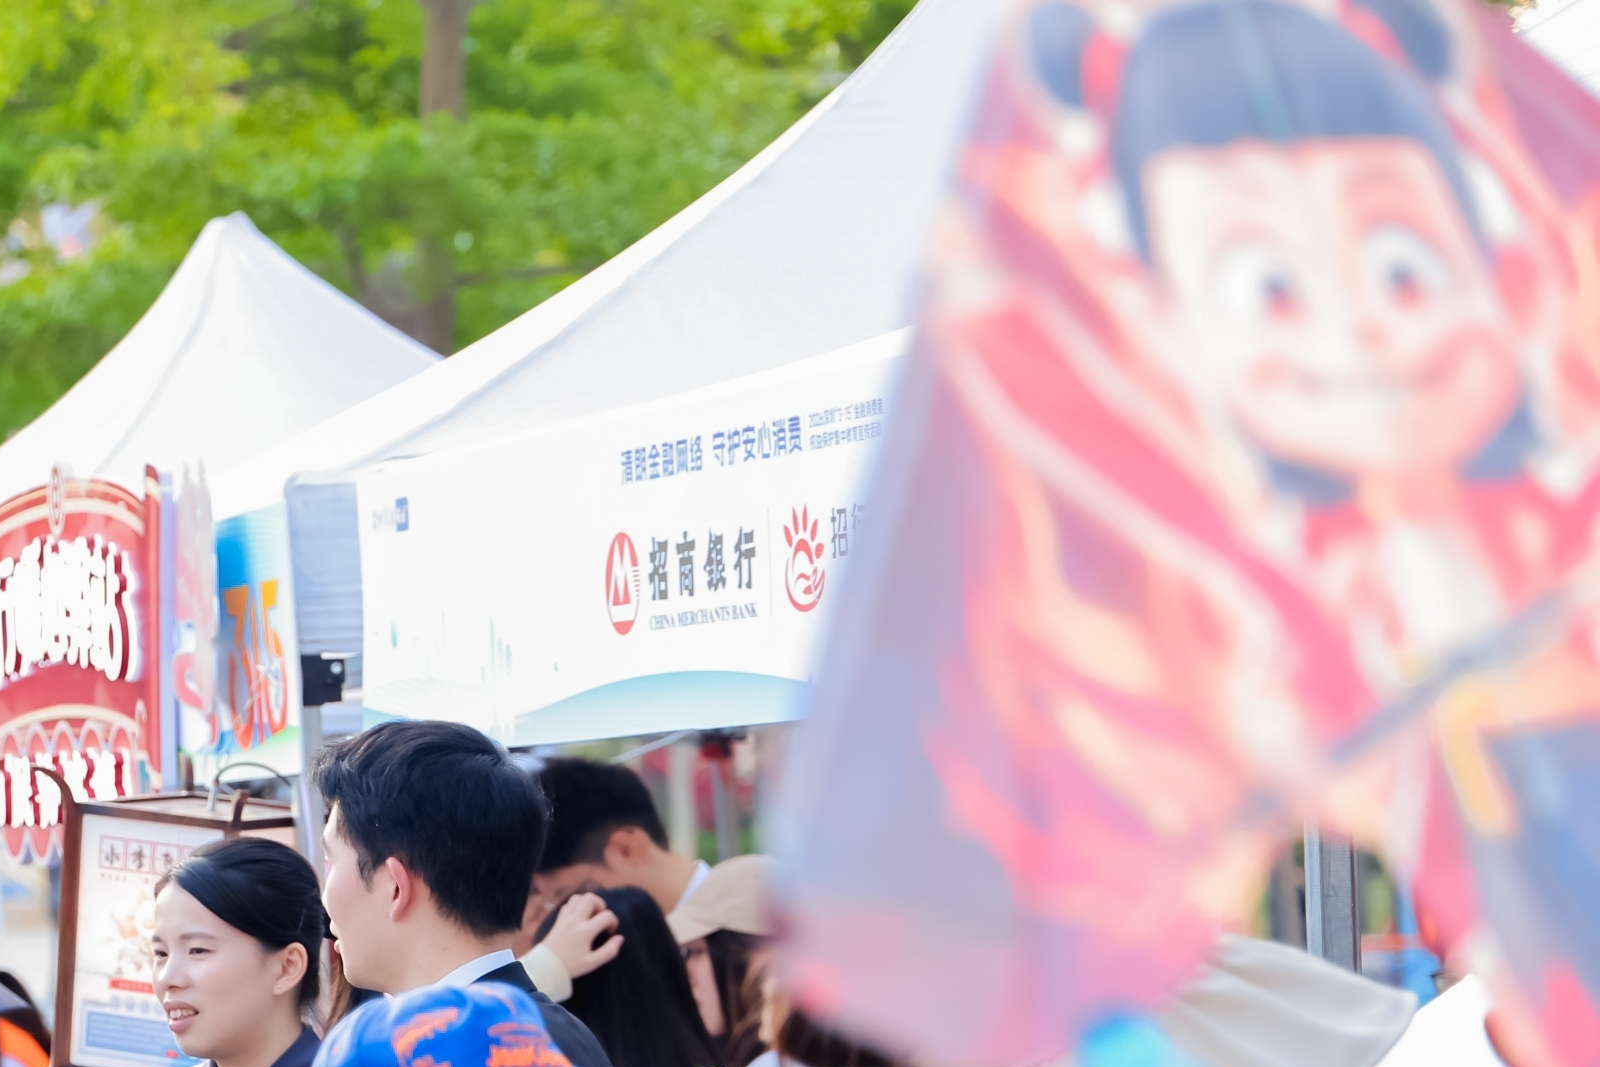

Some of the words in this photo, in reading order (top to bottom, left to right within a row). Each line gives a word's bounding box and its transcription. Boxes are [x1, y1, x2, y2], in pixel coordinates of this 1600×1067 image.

[621, 434, 703, 485] 清朗金融网络
[712, 415, 803, 467] 守护安心消费
[648, 525, 757, 602] 招商银行
[649, 613, 675, 631] CHINA
[677, 606, 730, 627] MERCHANTS
[732, 602, 758, 620] BANK
